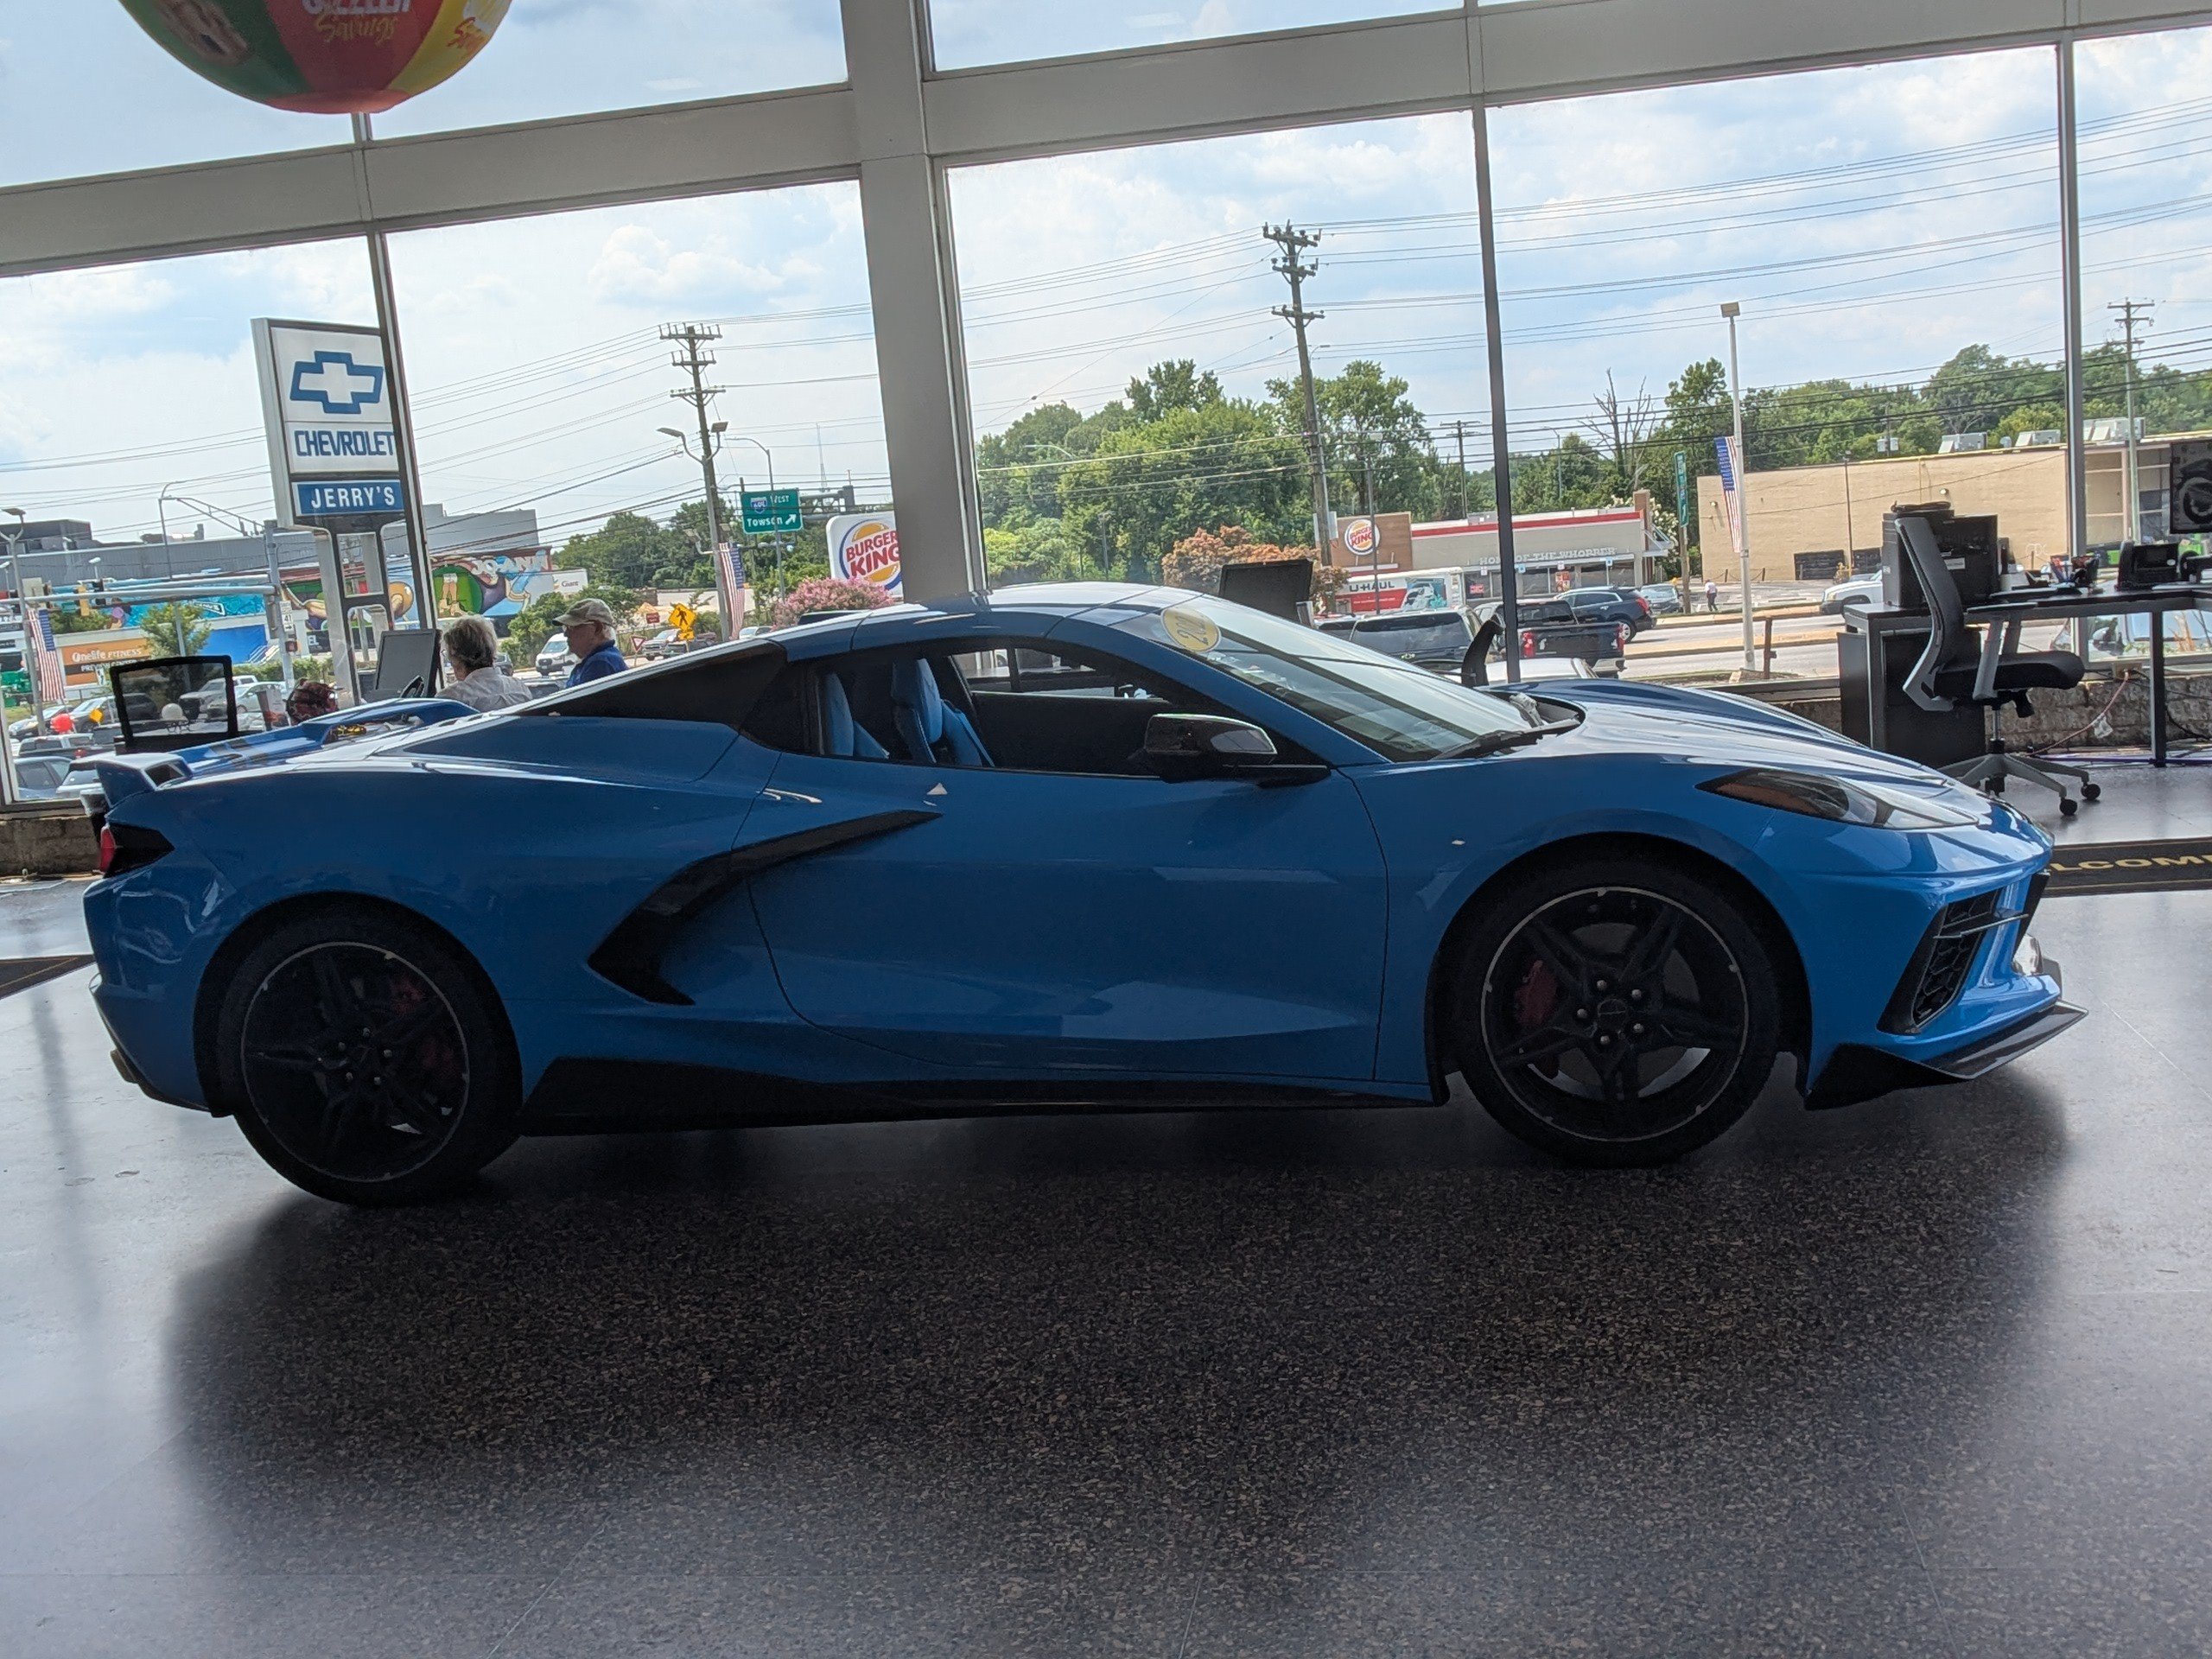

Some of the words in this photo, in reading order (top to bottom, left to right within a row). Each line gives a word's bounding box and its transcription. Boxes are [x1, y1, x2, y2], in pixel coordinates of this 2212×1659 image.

[294, 429, 395, 457] CHEVROLET
[311, 486, 395, 509] JERRY'S
[747, 517, 783, 527] Towson
[1533, 551, 1560, 561] THE
[72, 650, 106, 663] Onelife
[2050, 855, 2212, 871] LCOM
